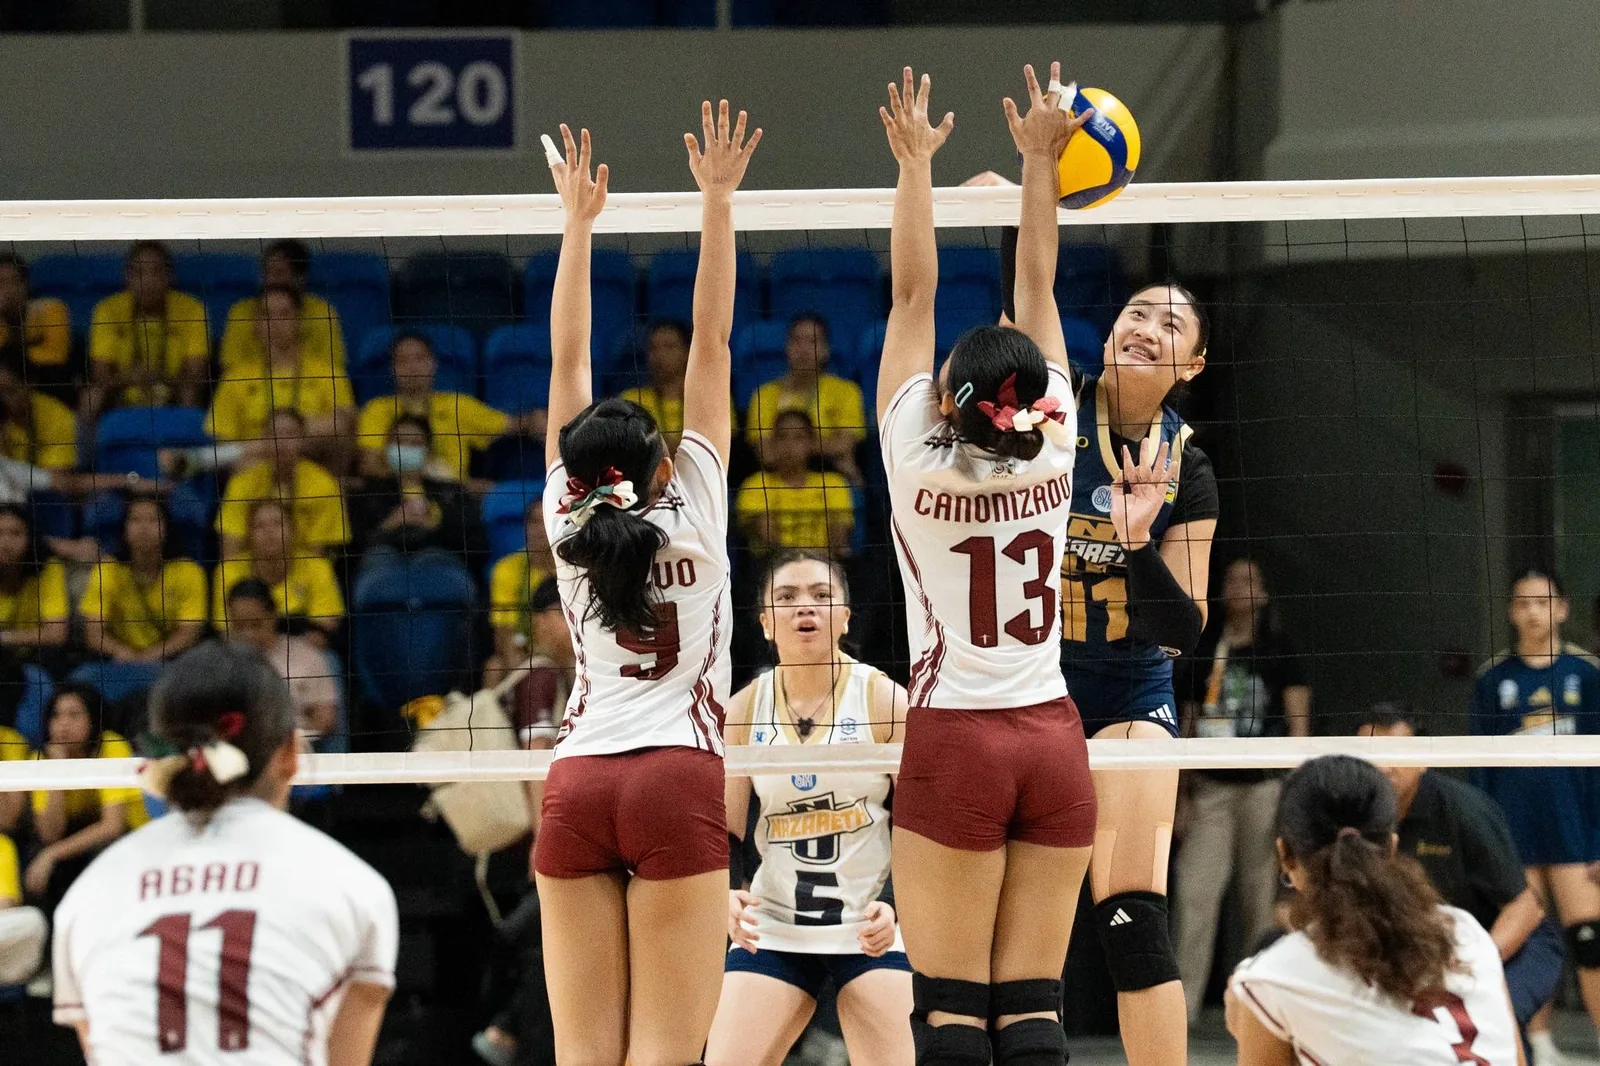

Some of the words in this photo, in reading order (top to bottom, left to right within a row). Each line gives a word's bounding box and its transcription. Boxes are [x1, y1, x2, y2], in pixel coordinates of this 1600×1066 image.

[357, 60, 507, 125] 120
[914, 473, 1071, 523] CANONIZADO
[950, 528, 1056, 648] 13
[615, 601, 680, 681] 9
[794, 870, 845, 926] 5
[134, 908, 258, 1054] 11
